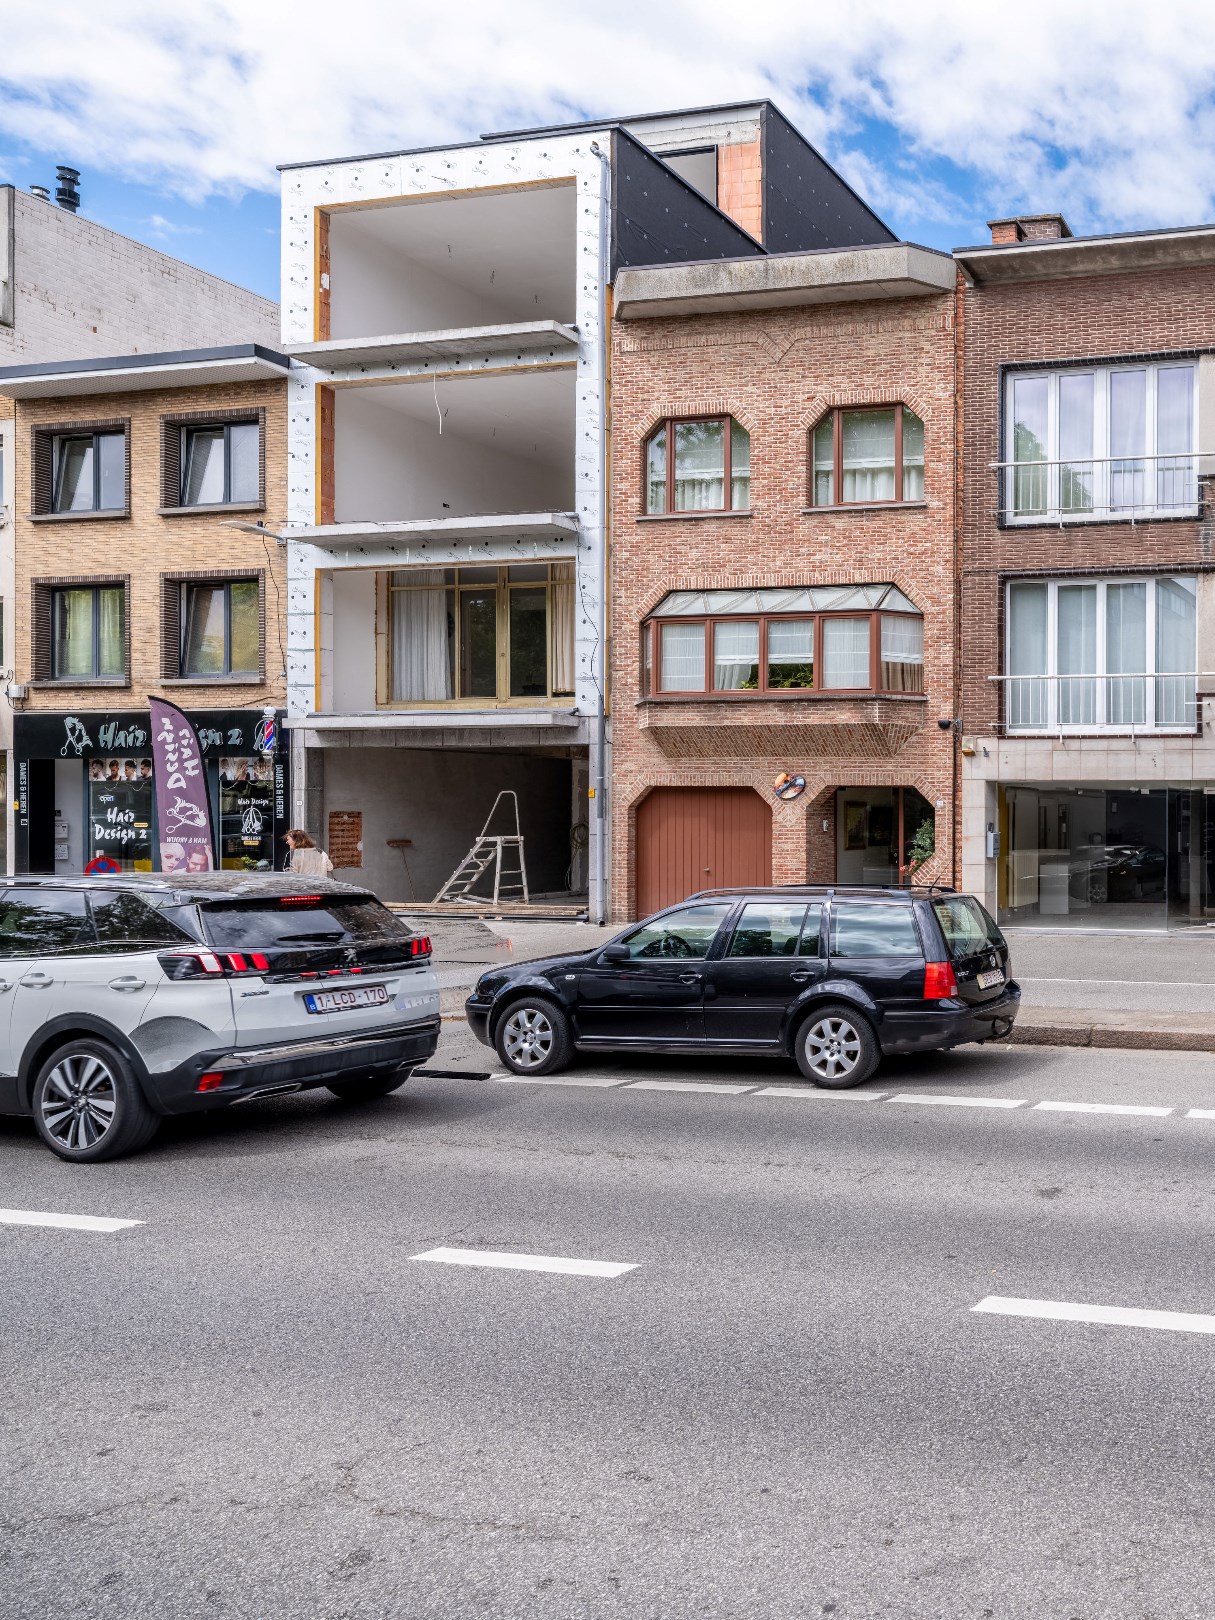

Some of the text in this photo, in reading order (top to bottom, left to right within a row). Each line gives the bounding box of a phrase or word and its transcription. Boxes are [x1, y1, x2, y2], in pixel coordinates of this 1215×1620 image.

[98, 722, 147, 750] Hair
[227, 728, 243, 745] 2
[19, 762, 27, 785] DAMES
[275, 764, 284, 788] DAMES
[19, 792, 27, 814] HEREN
[250, 798, 269, 806] Design
[275, 795, 284, 818] HEREN
[107, 806, 135, 824] Hair
[94, 823, 147, 844] Design 2
[317, 988, 385, 1008] 1-LCD-170
